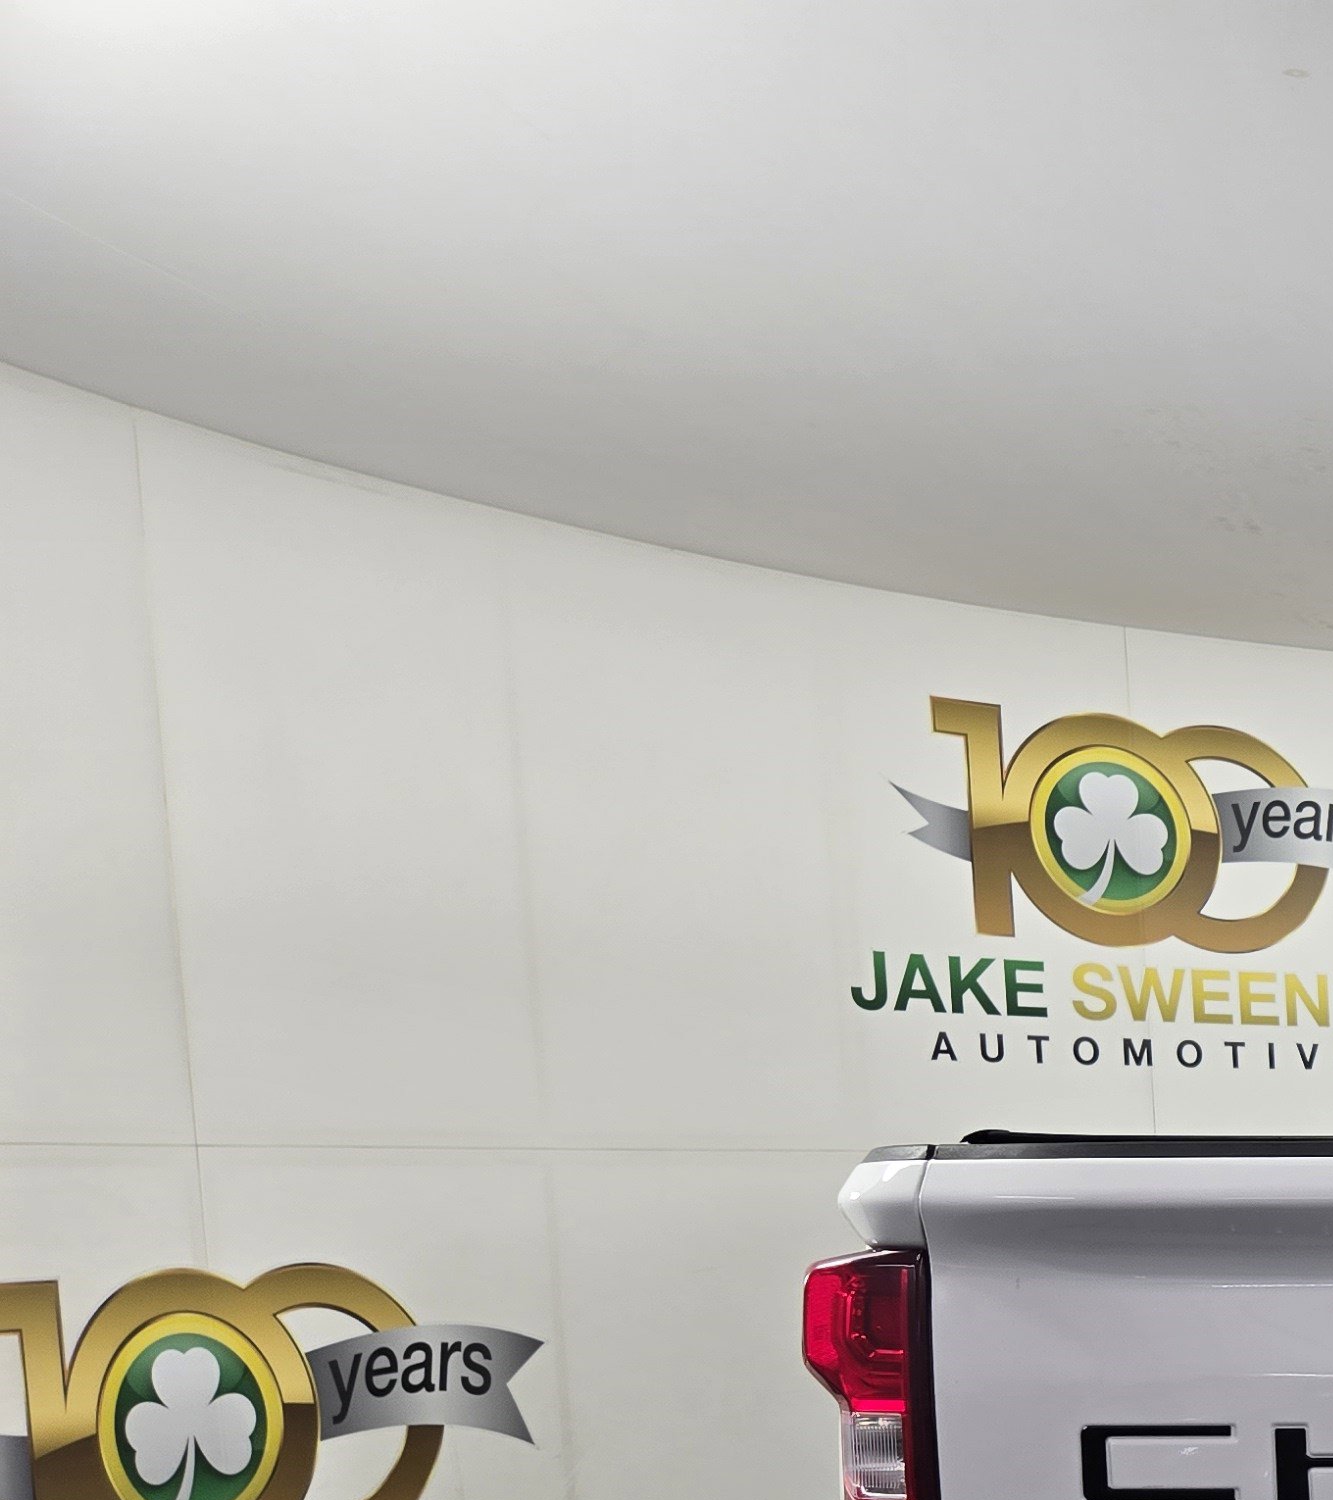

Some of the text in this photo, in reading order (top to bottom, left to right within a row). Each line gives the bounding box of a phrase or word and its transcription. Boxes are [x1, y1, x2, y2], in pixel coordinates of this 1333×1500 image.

[929, 695, 1330, 954] 100
[850, 949, 1048, 1018] JAKE
[328, 1339, 493, 1425] years
